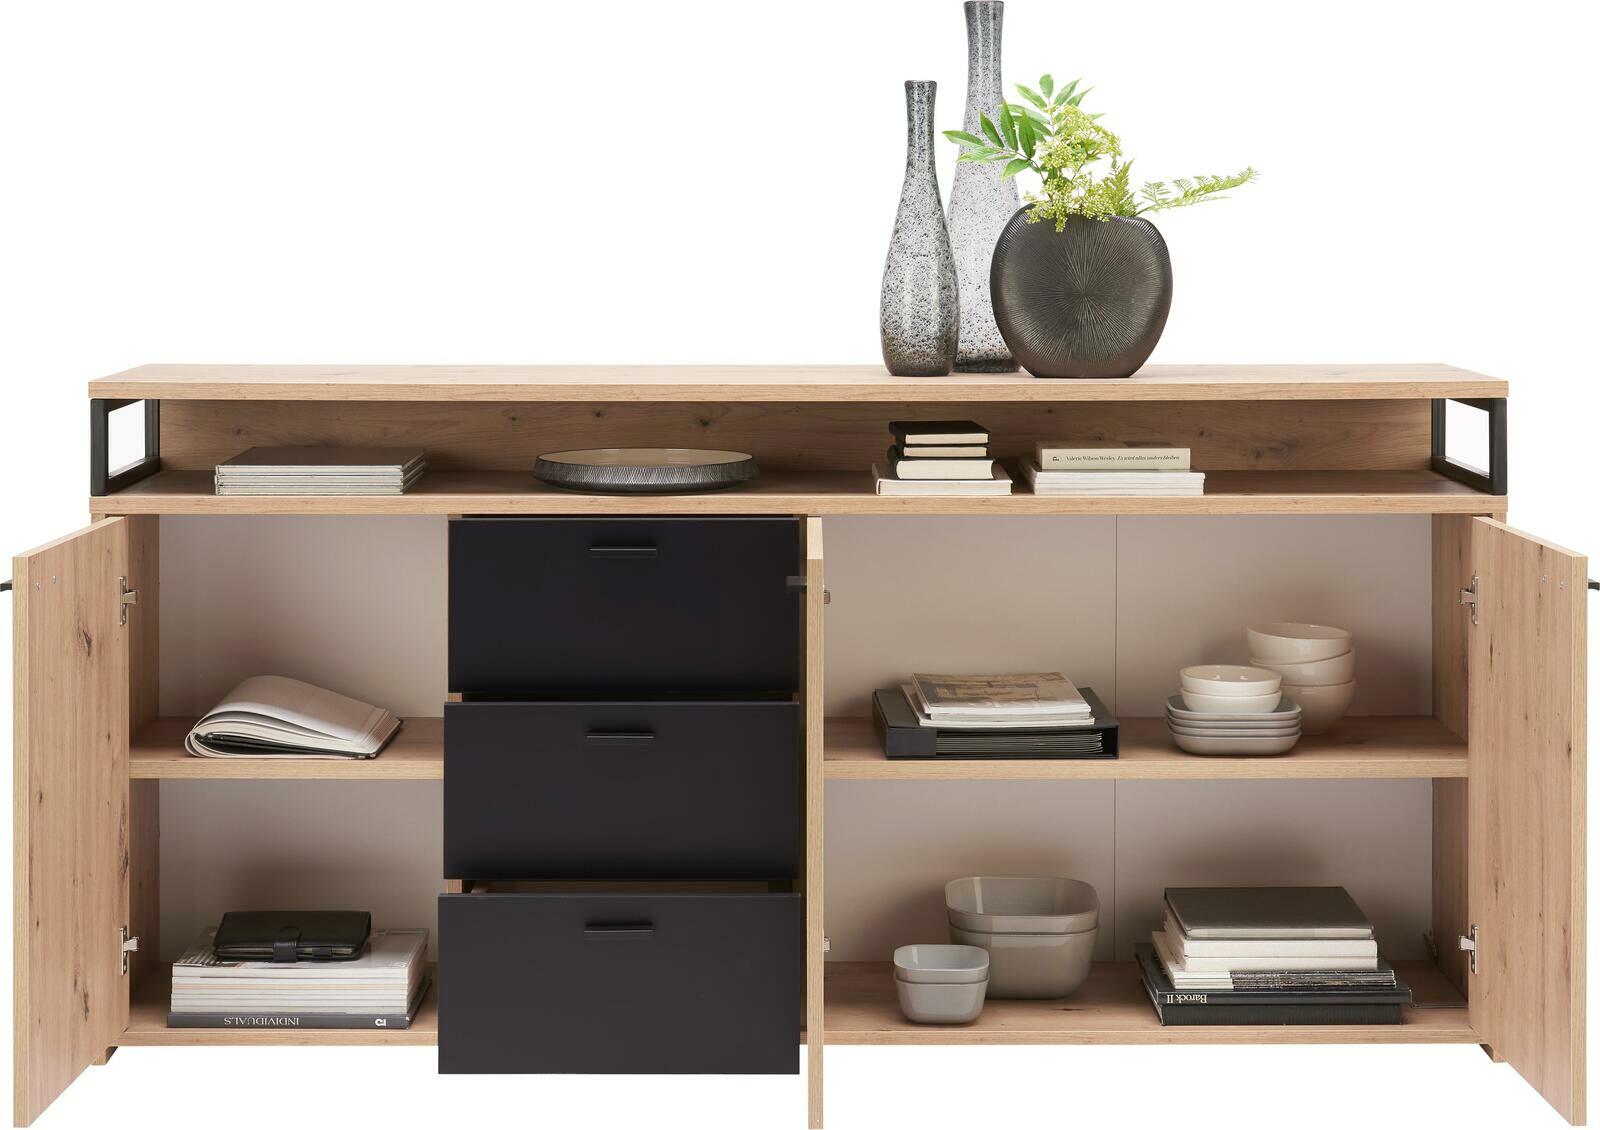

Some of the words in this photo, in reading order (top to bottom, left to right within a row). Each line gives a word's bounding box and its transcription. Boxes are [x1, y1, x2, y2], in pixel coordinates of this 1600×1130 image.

[1166, 994, 1174, 1003] II
[1175, 994, 1207, 1003] Barock
[223, 1017, 300, 1026] INDIVIDUALS
